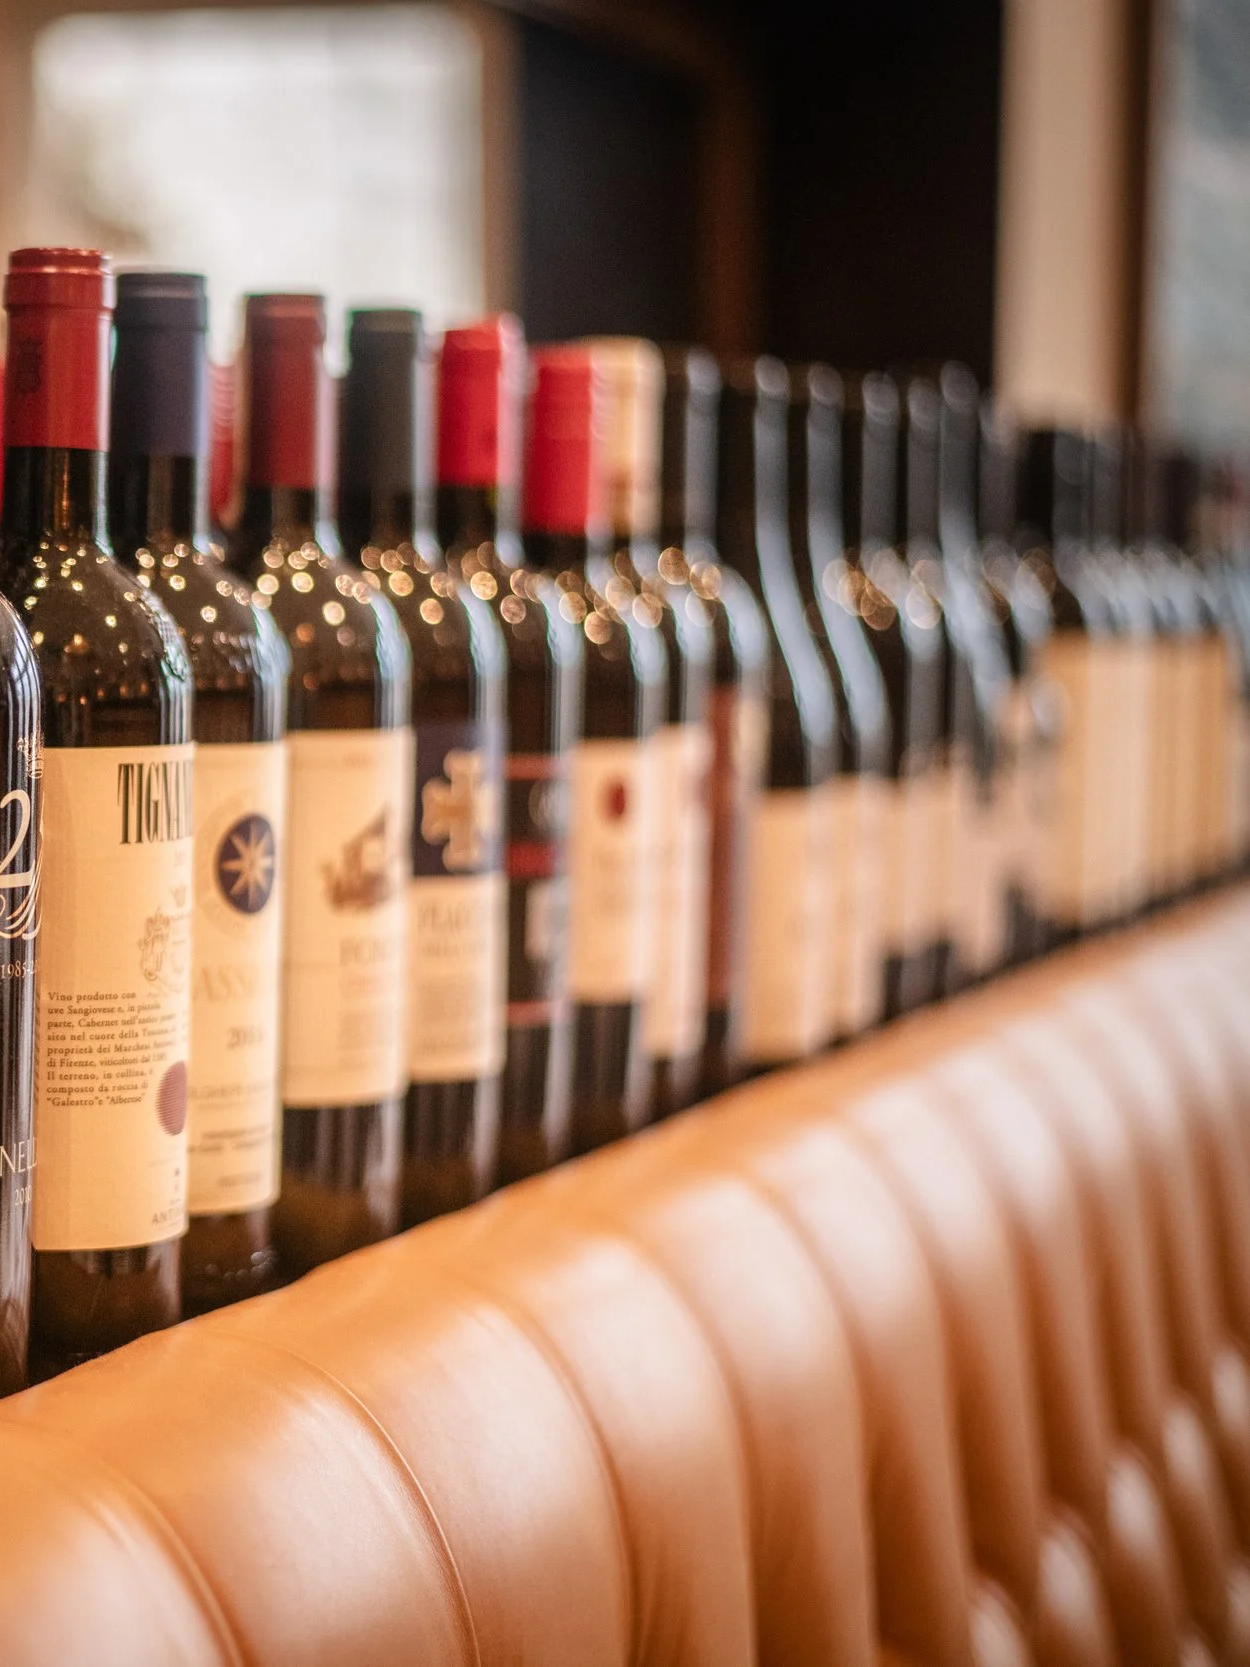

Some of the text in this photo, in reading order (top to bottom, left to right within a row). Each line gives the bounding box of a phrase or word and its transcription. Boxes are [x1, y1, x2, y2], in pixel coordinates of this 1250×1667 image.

[47, 991, 137, 1003] Vino prodotto con
[47, 1007, 64, 1015] uve
[67, 1005, 115, 1017] Sangiovese
[127, 1004, 135, 1012] in
[47, 1020, 75, 1030] parte,
[78, 1018, 119, 1028] Cabernet
[47, 1033, 66, 1041] sito
[70, 1032, 86, 1041] nel
[89, 1033, 116, 1041] cuore
[118, 1030, 139, 1040] della
[47, 1045, 93, 1057] proprietà
[96, 1043, 111, 1053] dei
[47, 1058, 56, 1068] di
[59, 1058, 97, 1068] Firenze,
[47, 1071, 55, 1080] Il
[59, 1072, 99, 1081] terreno,
[103, 1070, 112, 1079] in
[46, 1084, 94, 1096] composto
[98, 1083, 109, 1092] da
[112, 1082, 138, 1092] roccia
